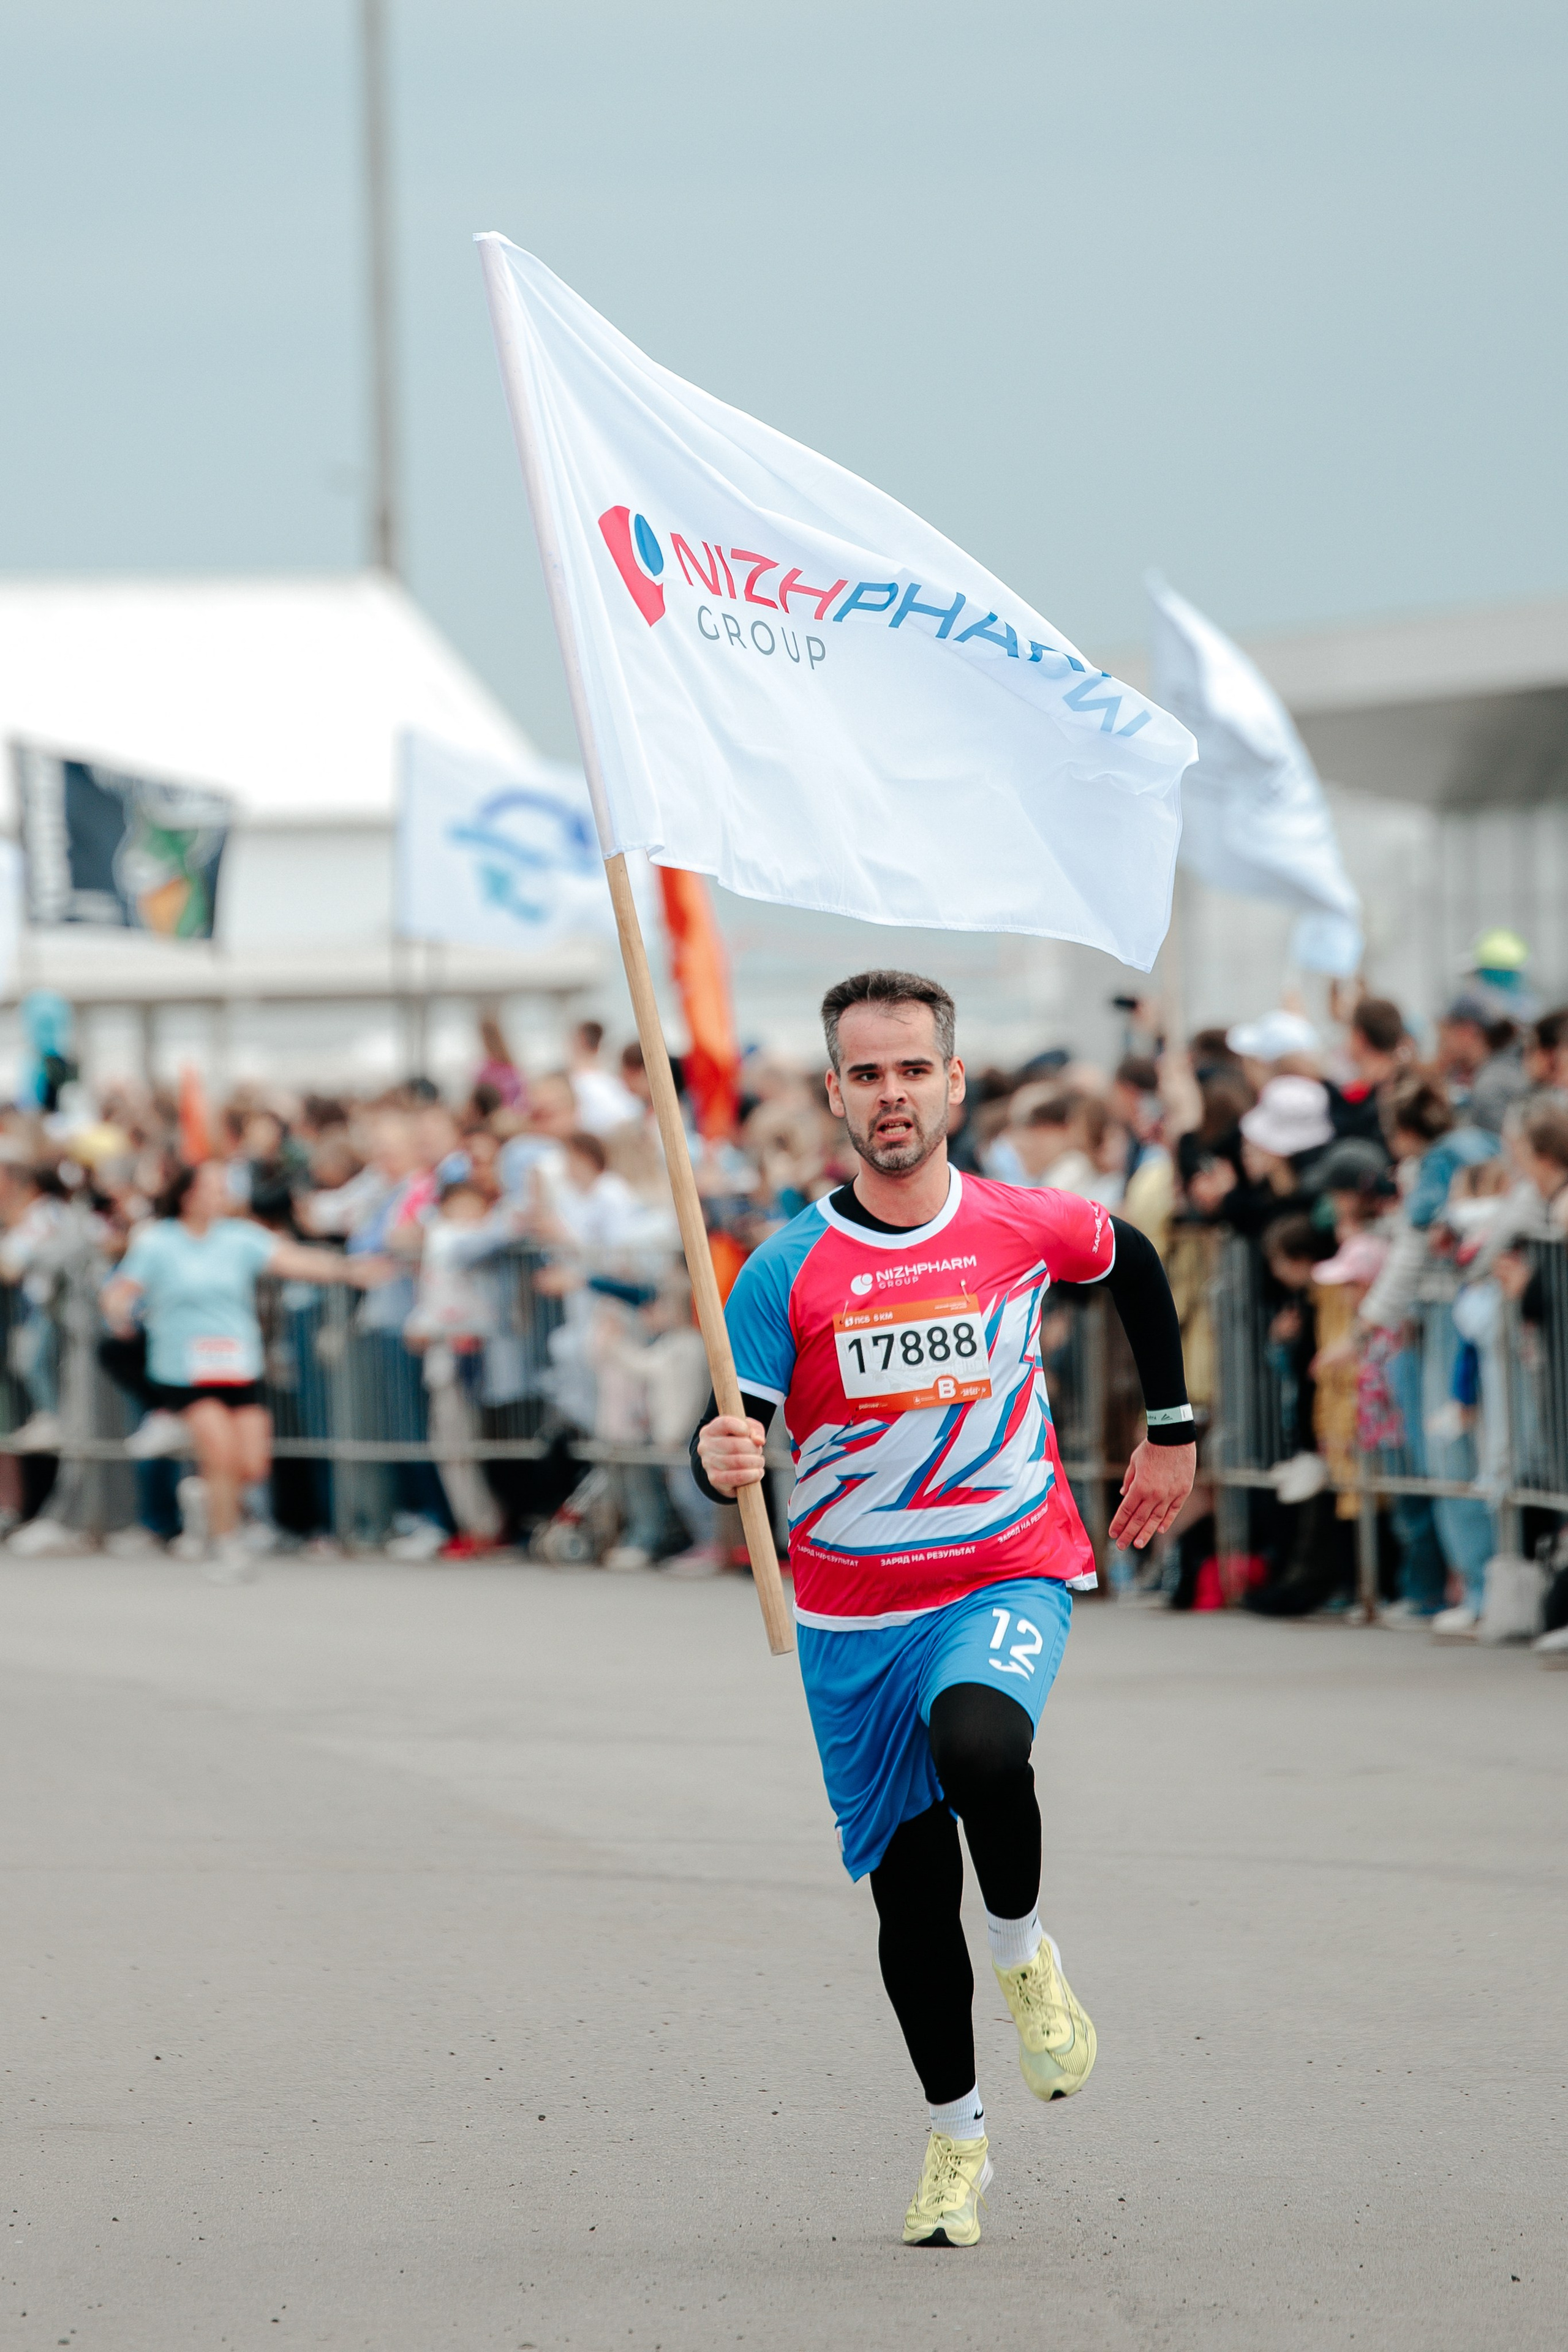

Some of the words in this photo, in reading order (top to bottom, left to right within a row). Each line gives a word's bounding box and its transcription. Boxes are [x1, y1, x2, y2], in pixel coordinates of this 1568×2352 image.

[698, 605, 826, 670] GROUP
[876, 1254, 977, 1283] NIZHPHARM
[878, 1276, 919, 1289] GROUP
[848, 1322, 977, 1374] 17888
[880, 1555, 910, 1567] ЗАРЯД
[911, 1553, 925, 1562] НА
[927, 1545, 976, 1561] РЕЗУЛЬТАТ
[989, 1608, 1043, 1675] 12
